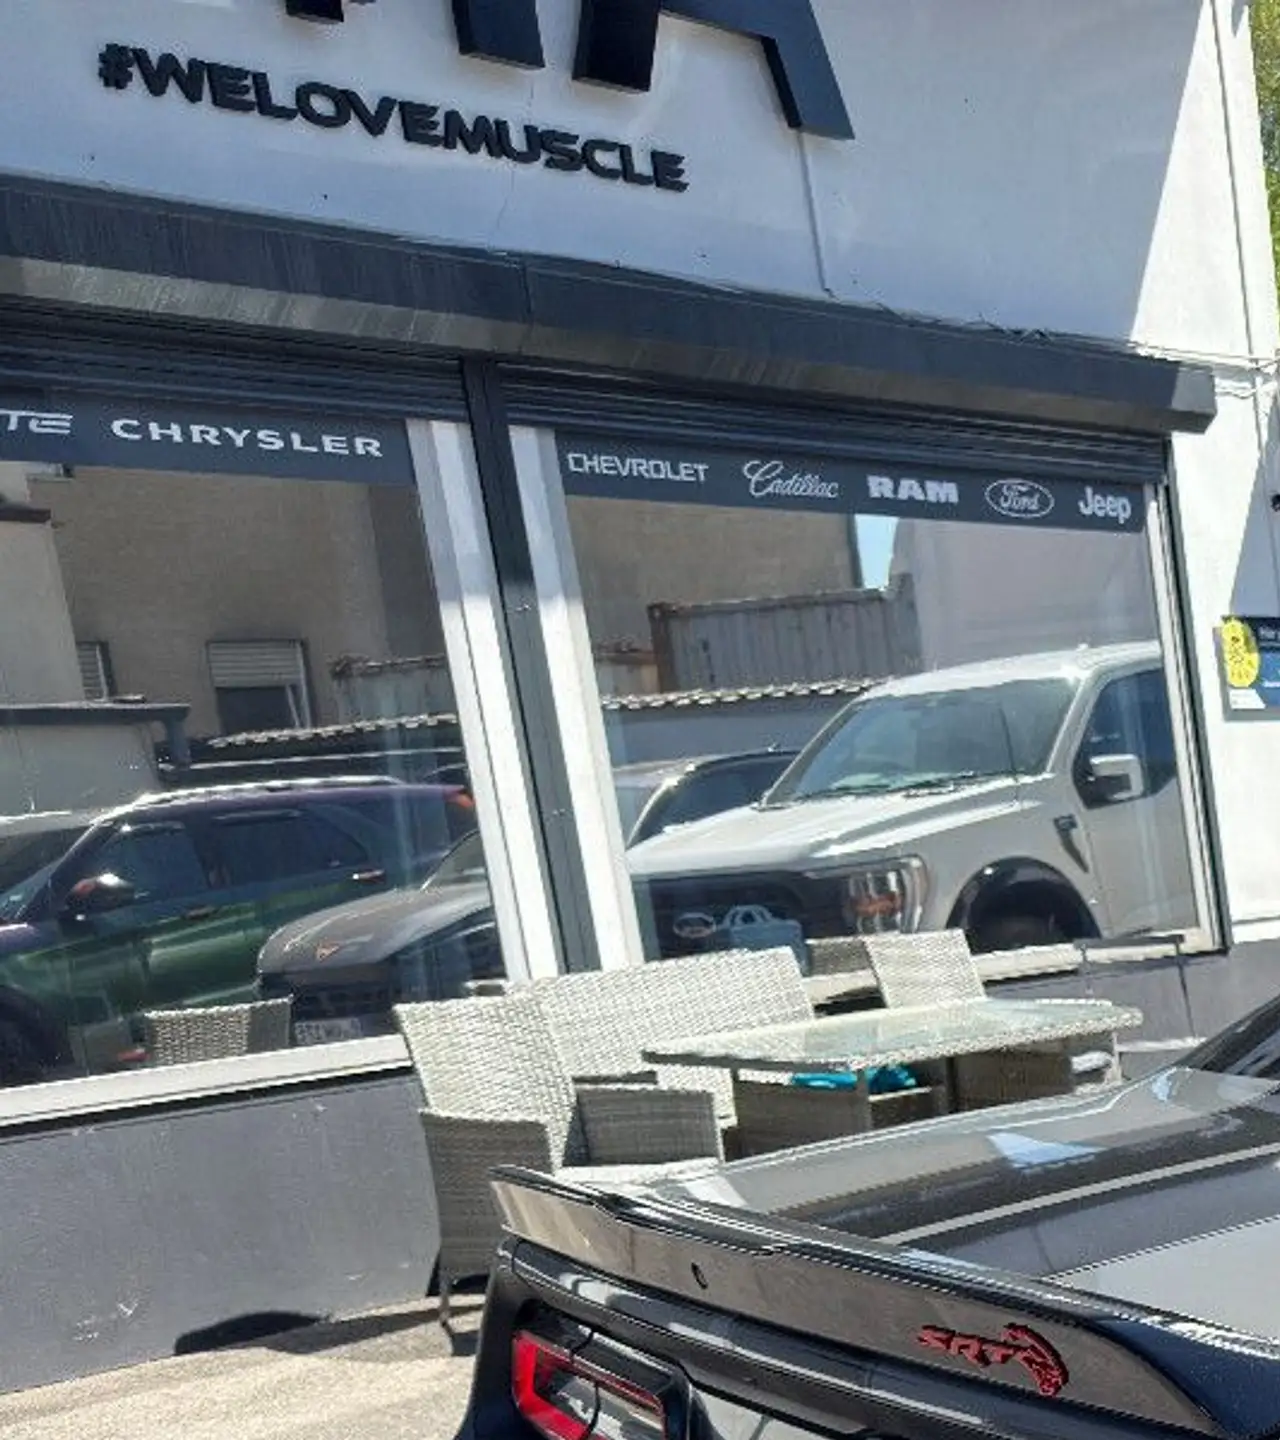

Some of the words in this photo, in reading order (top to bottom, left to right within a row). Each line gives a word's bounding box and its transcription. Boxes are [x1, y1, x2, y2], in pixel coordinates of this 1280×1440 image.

[97, 42, 689, 192] #WELOVEMUSCLE
[111, 418, 384, 458] CHRYSLER
[567, 453, 709, 482] CHEVROLET
[742, 460, 839, 498] Cadillac
[866, 475, 959, 503] RAM
[999, 483, 1041, 511] Ford
[1078, 485, 1132, 524] Jeep
[917, 1325, 1020, 1368] SRT
